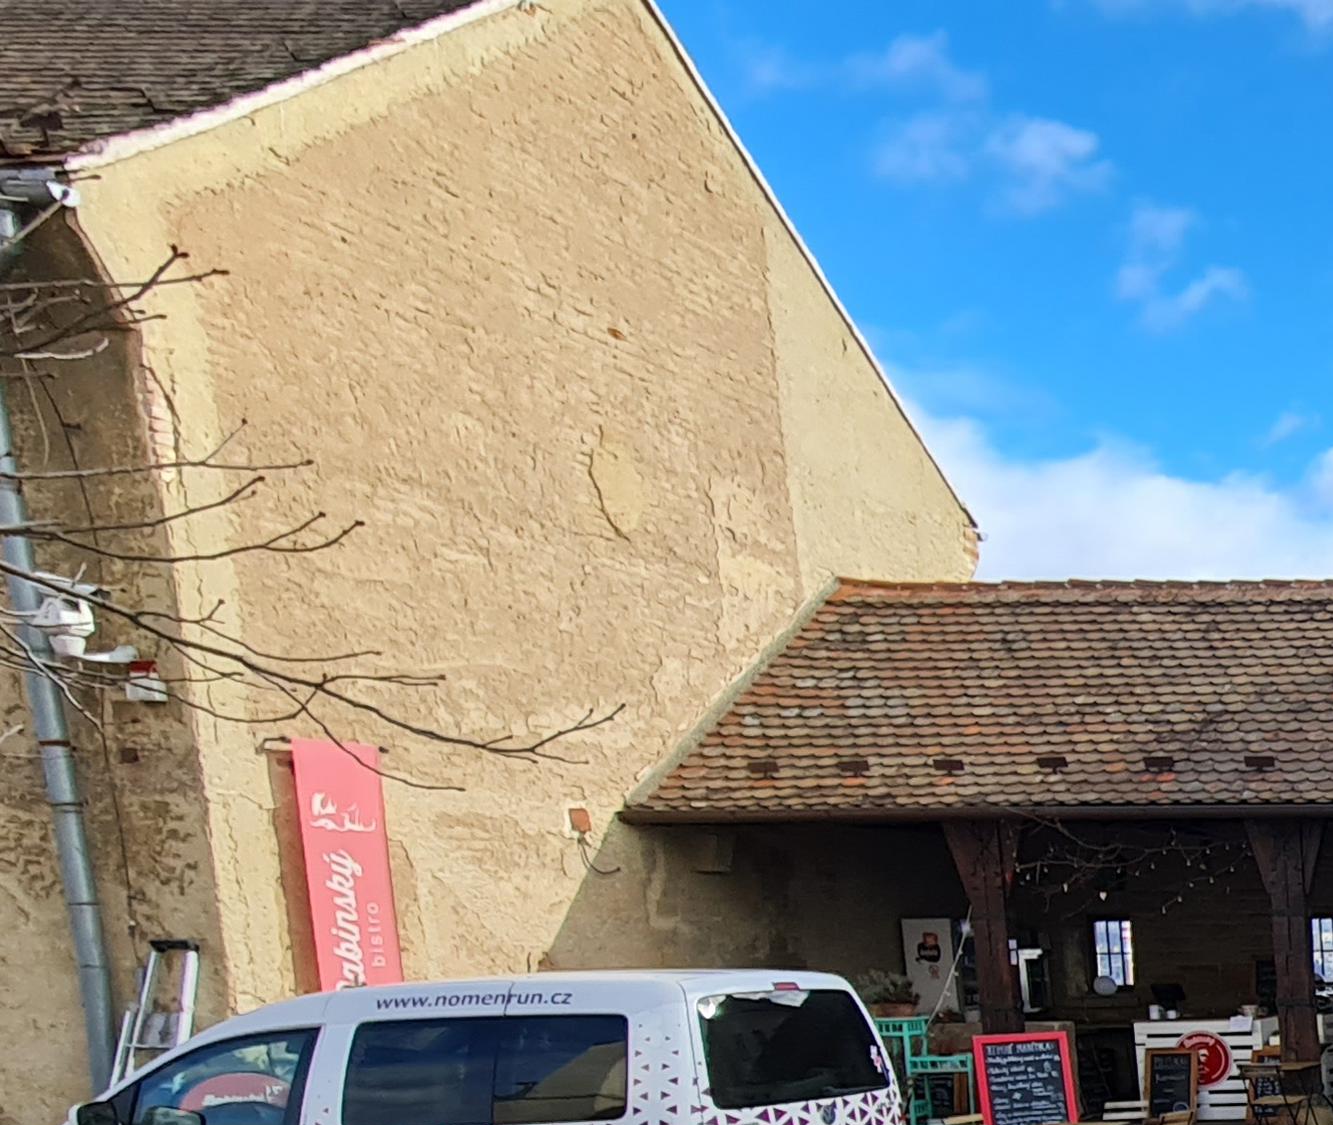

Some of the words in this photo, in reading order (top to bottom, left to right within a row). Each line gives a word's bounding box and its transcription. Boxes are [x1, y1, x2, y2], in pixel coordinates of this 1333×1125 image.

[322, 849, 369, 991] abinský
[366, 901, 387, 968] bistro
[376, 991, 574, 1010] www.nomenrun.cz
